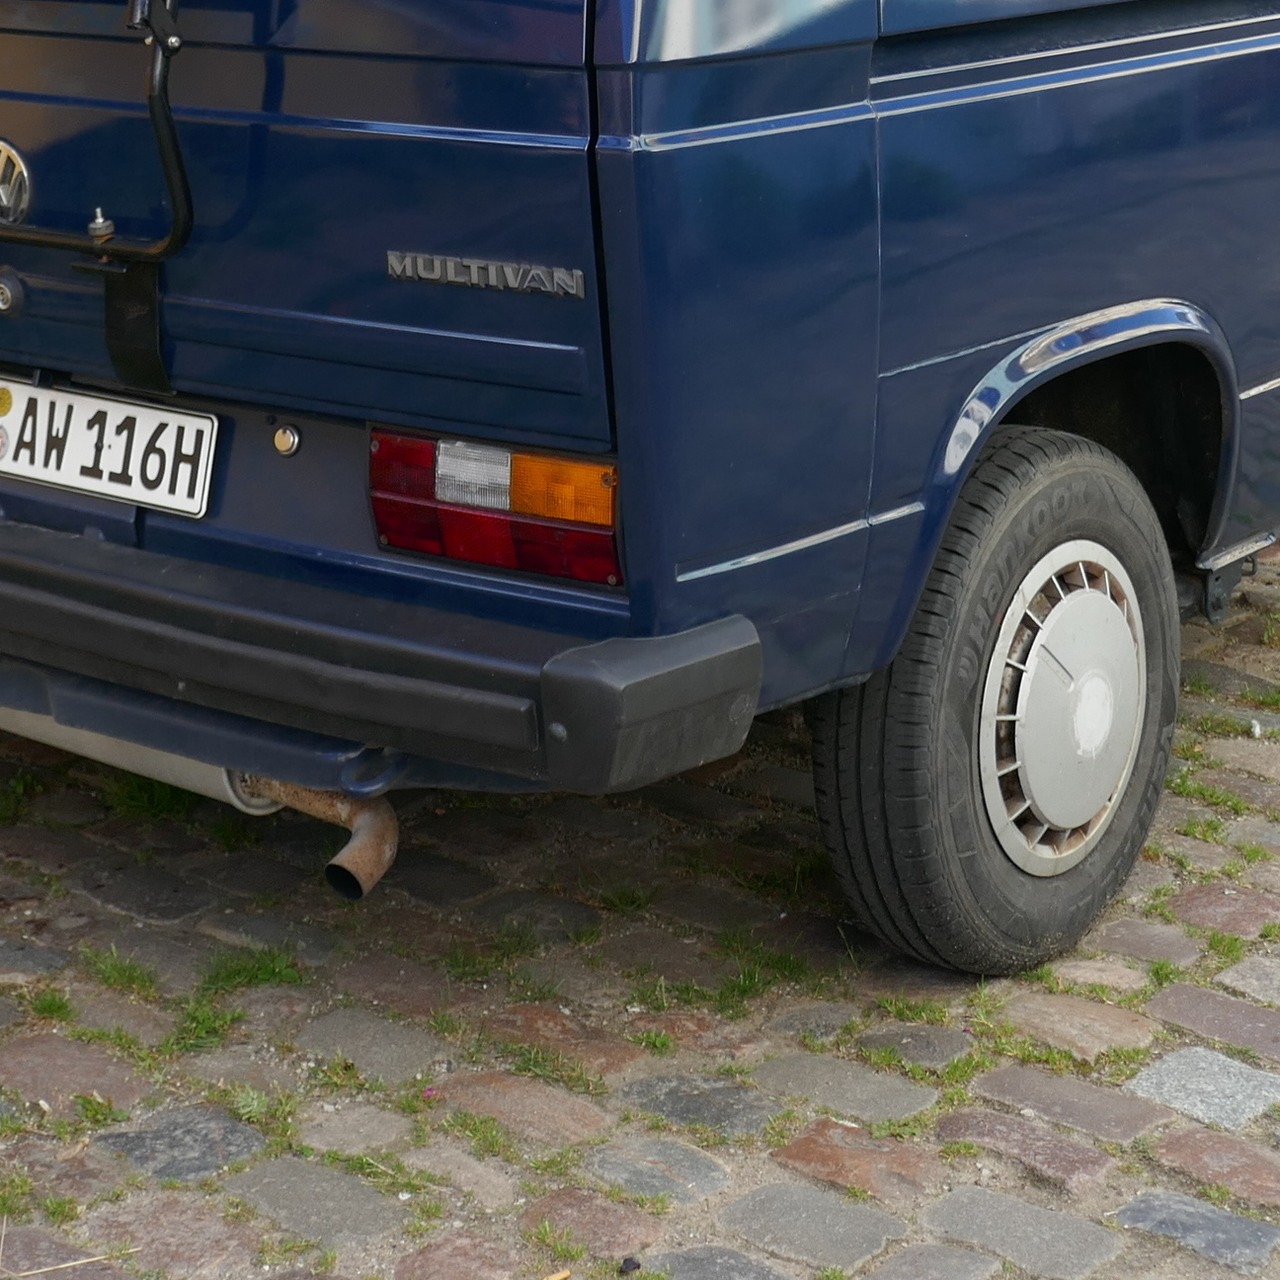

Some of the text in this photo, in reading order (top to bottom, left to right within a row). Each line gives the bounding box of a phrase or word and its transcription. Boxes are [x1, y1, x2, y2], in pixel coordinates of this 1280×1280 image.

[387, 250, 586, 299] MULTIVAN
[11, 396, 74, 472] AW
[79, 409, 205, 500] 116H
